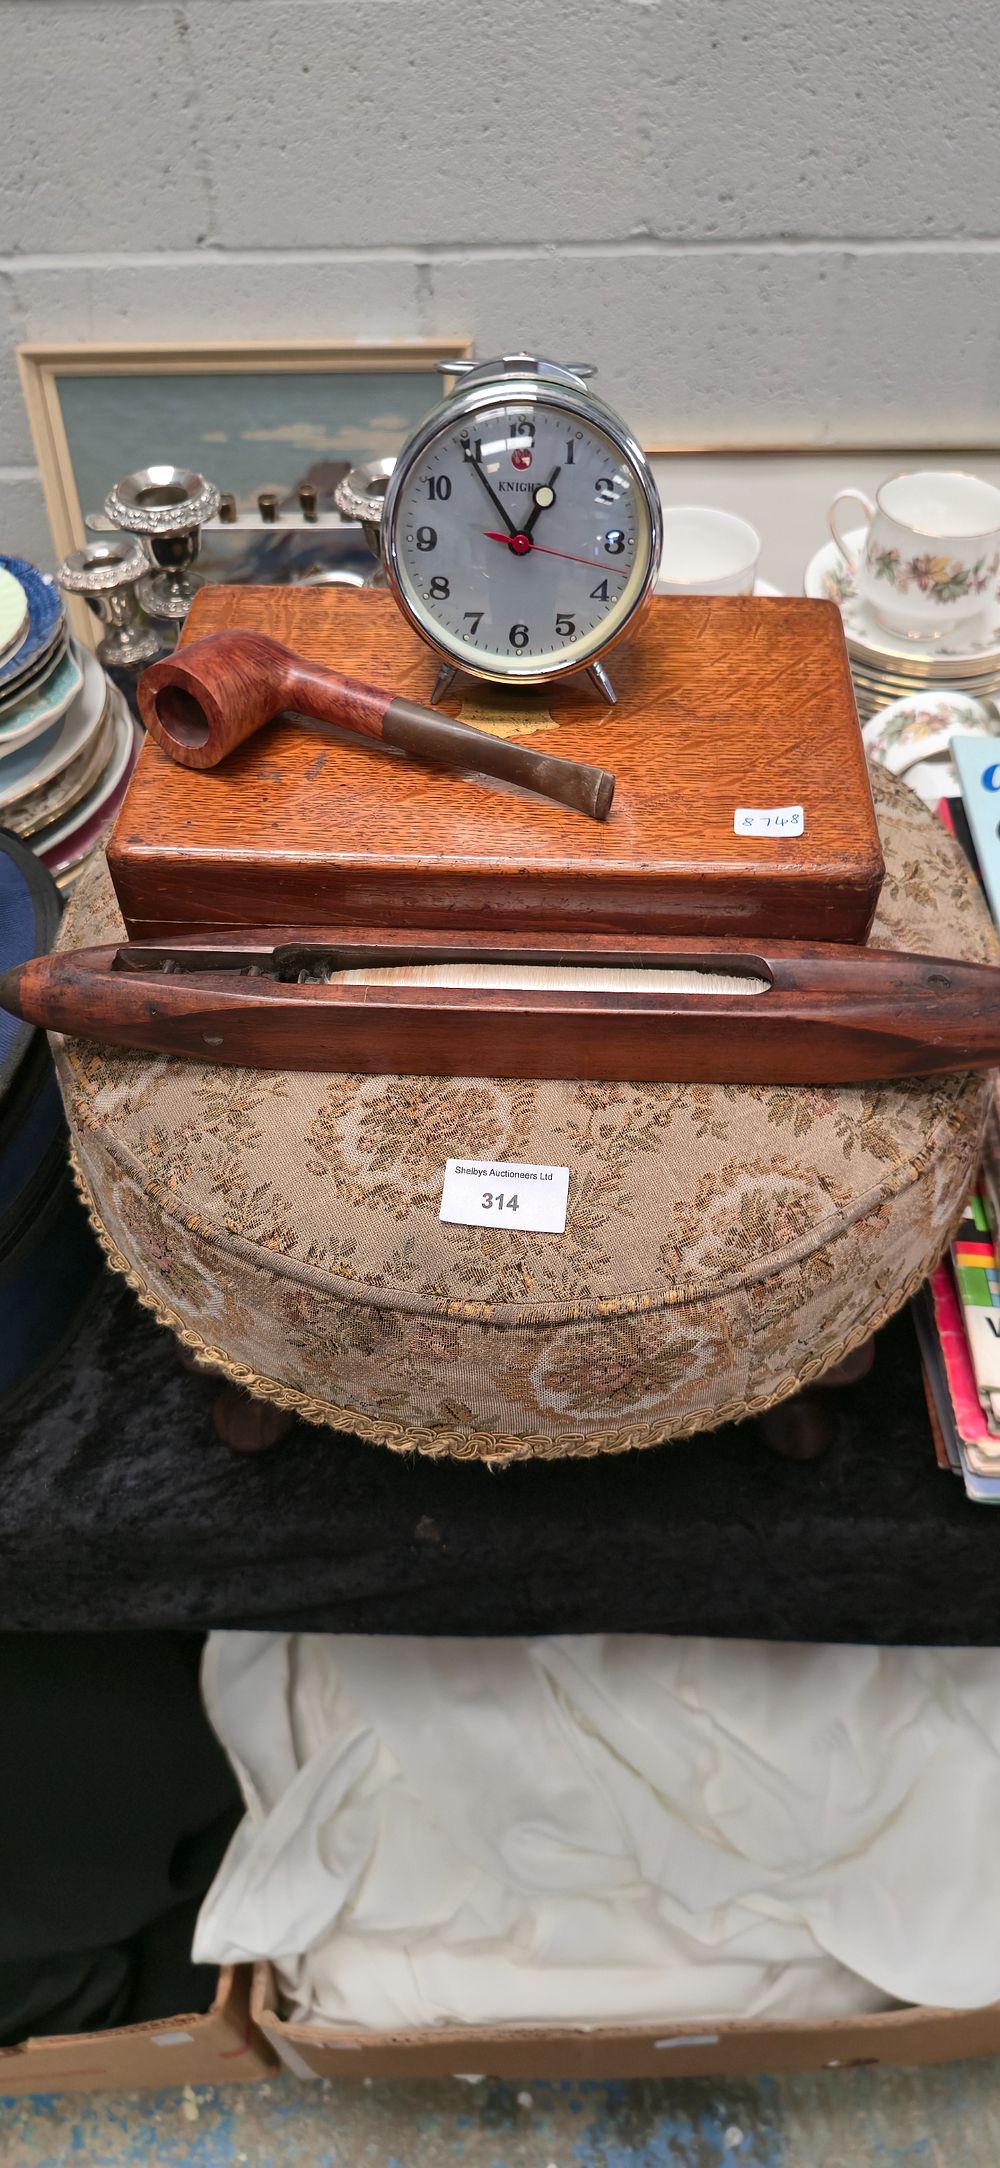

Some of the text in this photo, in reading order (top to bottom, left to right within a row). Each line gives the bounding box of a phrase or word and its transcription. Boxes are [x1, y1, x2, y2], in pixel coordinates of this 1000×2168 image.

[509, 422, 536, 448] 12
[565, 439, 576, 465] 1
[427, 475, 451, 501] 10
[595, 478, 615, 502] 2
[416, 526, 437, 551] 9
[604, 529, 625, 555] 3
[429, 576, 450, 601] 8
[589, 579, 610, 602] 4
[463, 612, 484, 635] 7
[555, 613, 576, 636] 5
[509, 624, 529, 648] 6
[454, 1166, 553, 1181] Shelbys Auctioneers Ltd
[481, 1192, 520, 1212] 314
